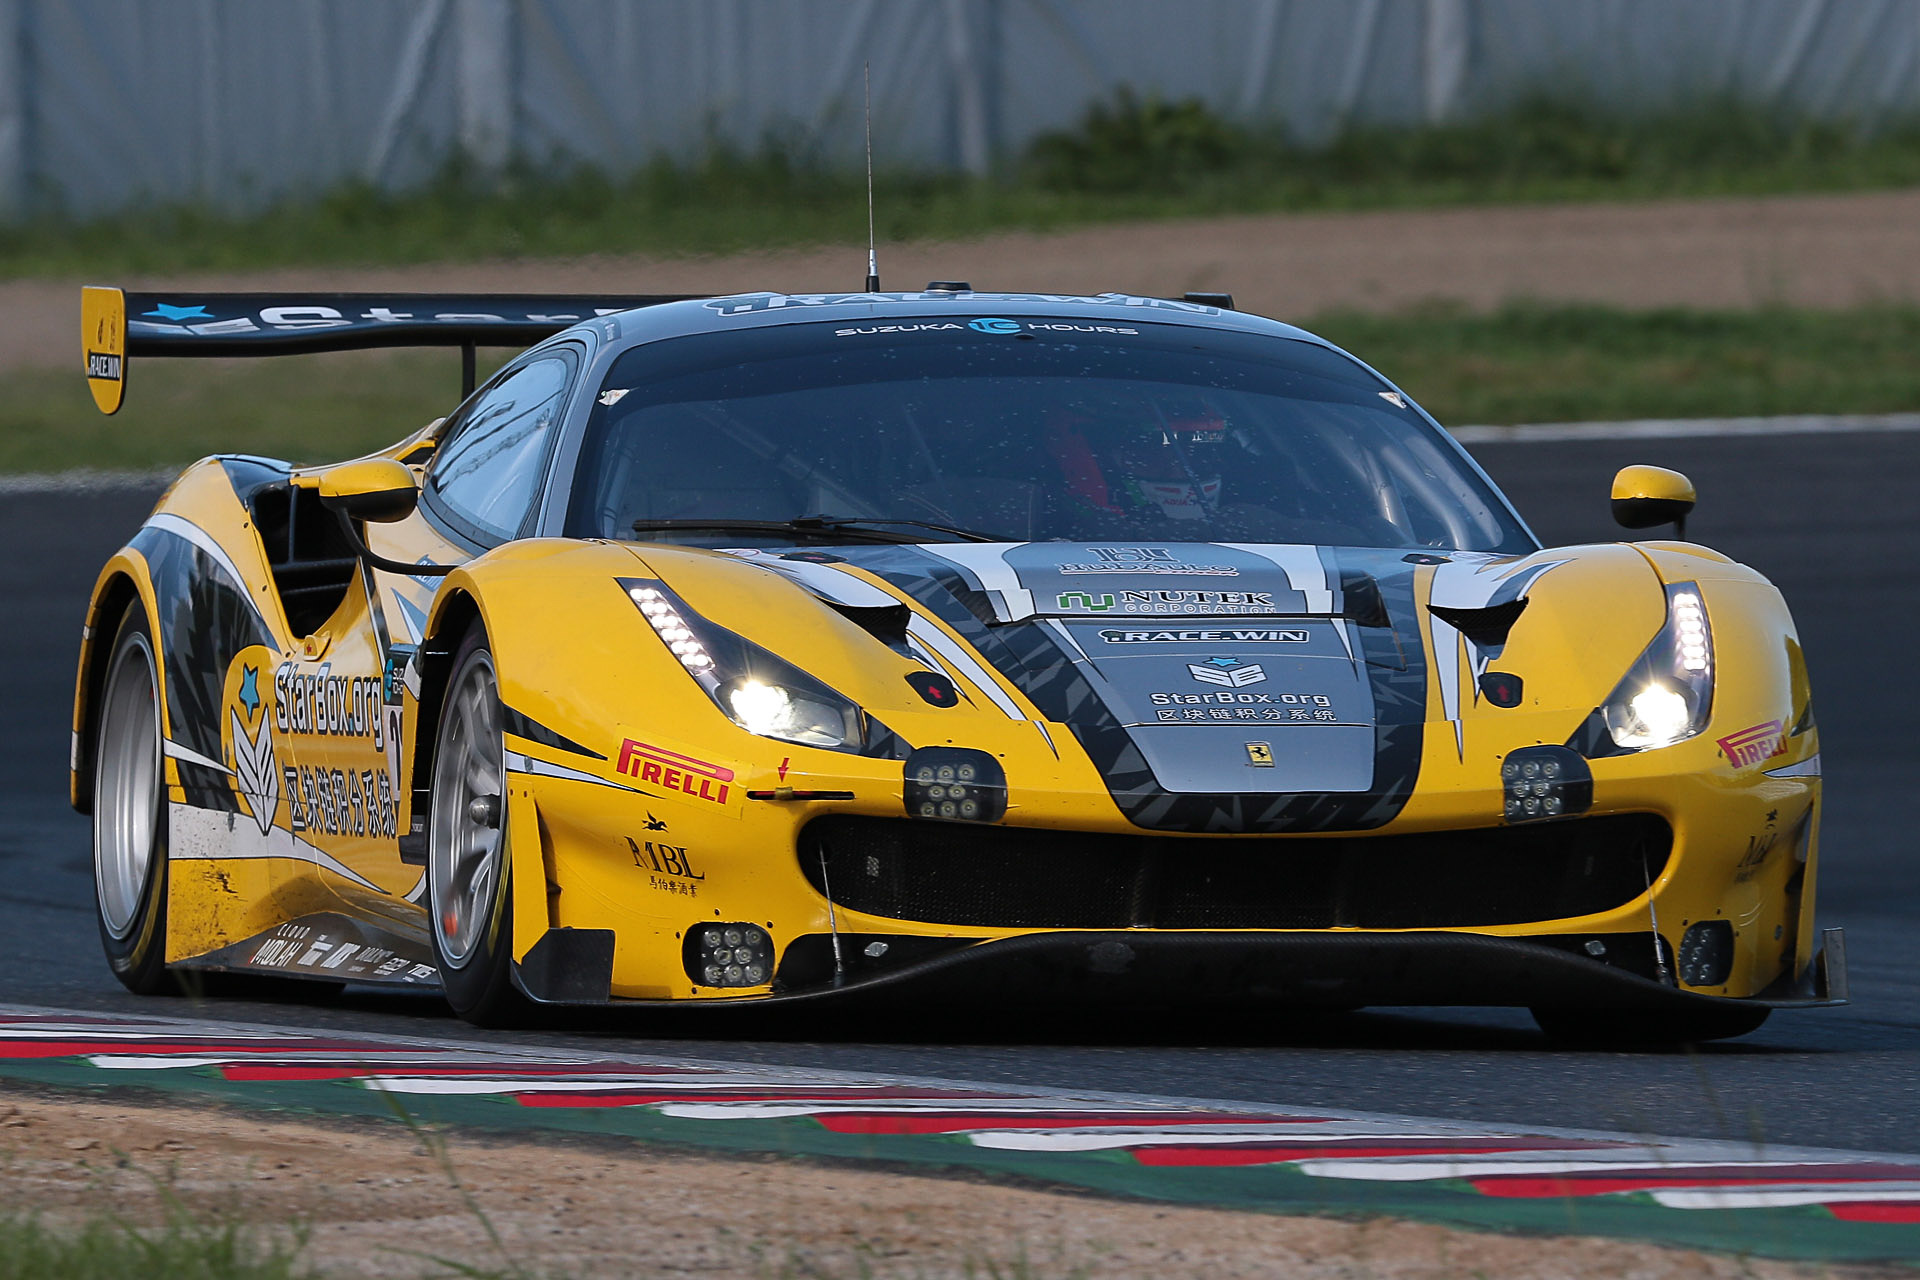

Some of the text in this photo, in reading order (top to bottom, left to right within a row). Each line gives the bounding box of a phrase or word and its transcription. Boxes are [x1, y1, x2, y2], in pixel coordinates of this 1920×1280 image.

[835, 322, 963, 337] SUZUKA
[1027, 322, 1139, 335] HOURS
[1119, 590, 1276, 607] NUTEK
[1124, 603, 1277, 615] CORPORATION
[274, 660, 384, 752] StarBox.org
[1150, 691, 1331, 708] StarBox.org
[1156, 708, 1337, 722] 区块链积分系统
[1715, 719, 1790, 769] PIRELLI
[616, 738, 735, 805] PIRELLI
[624, 836, 706, 881] MBL
[277, 923, 311, 940] CLOUD
[250, 938, 304, 967] MOLAH
